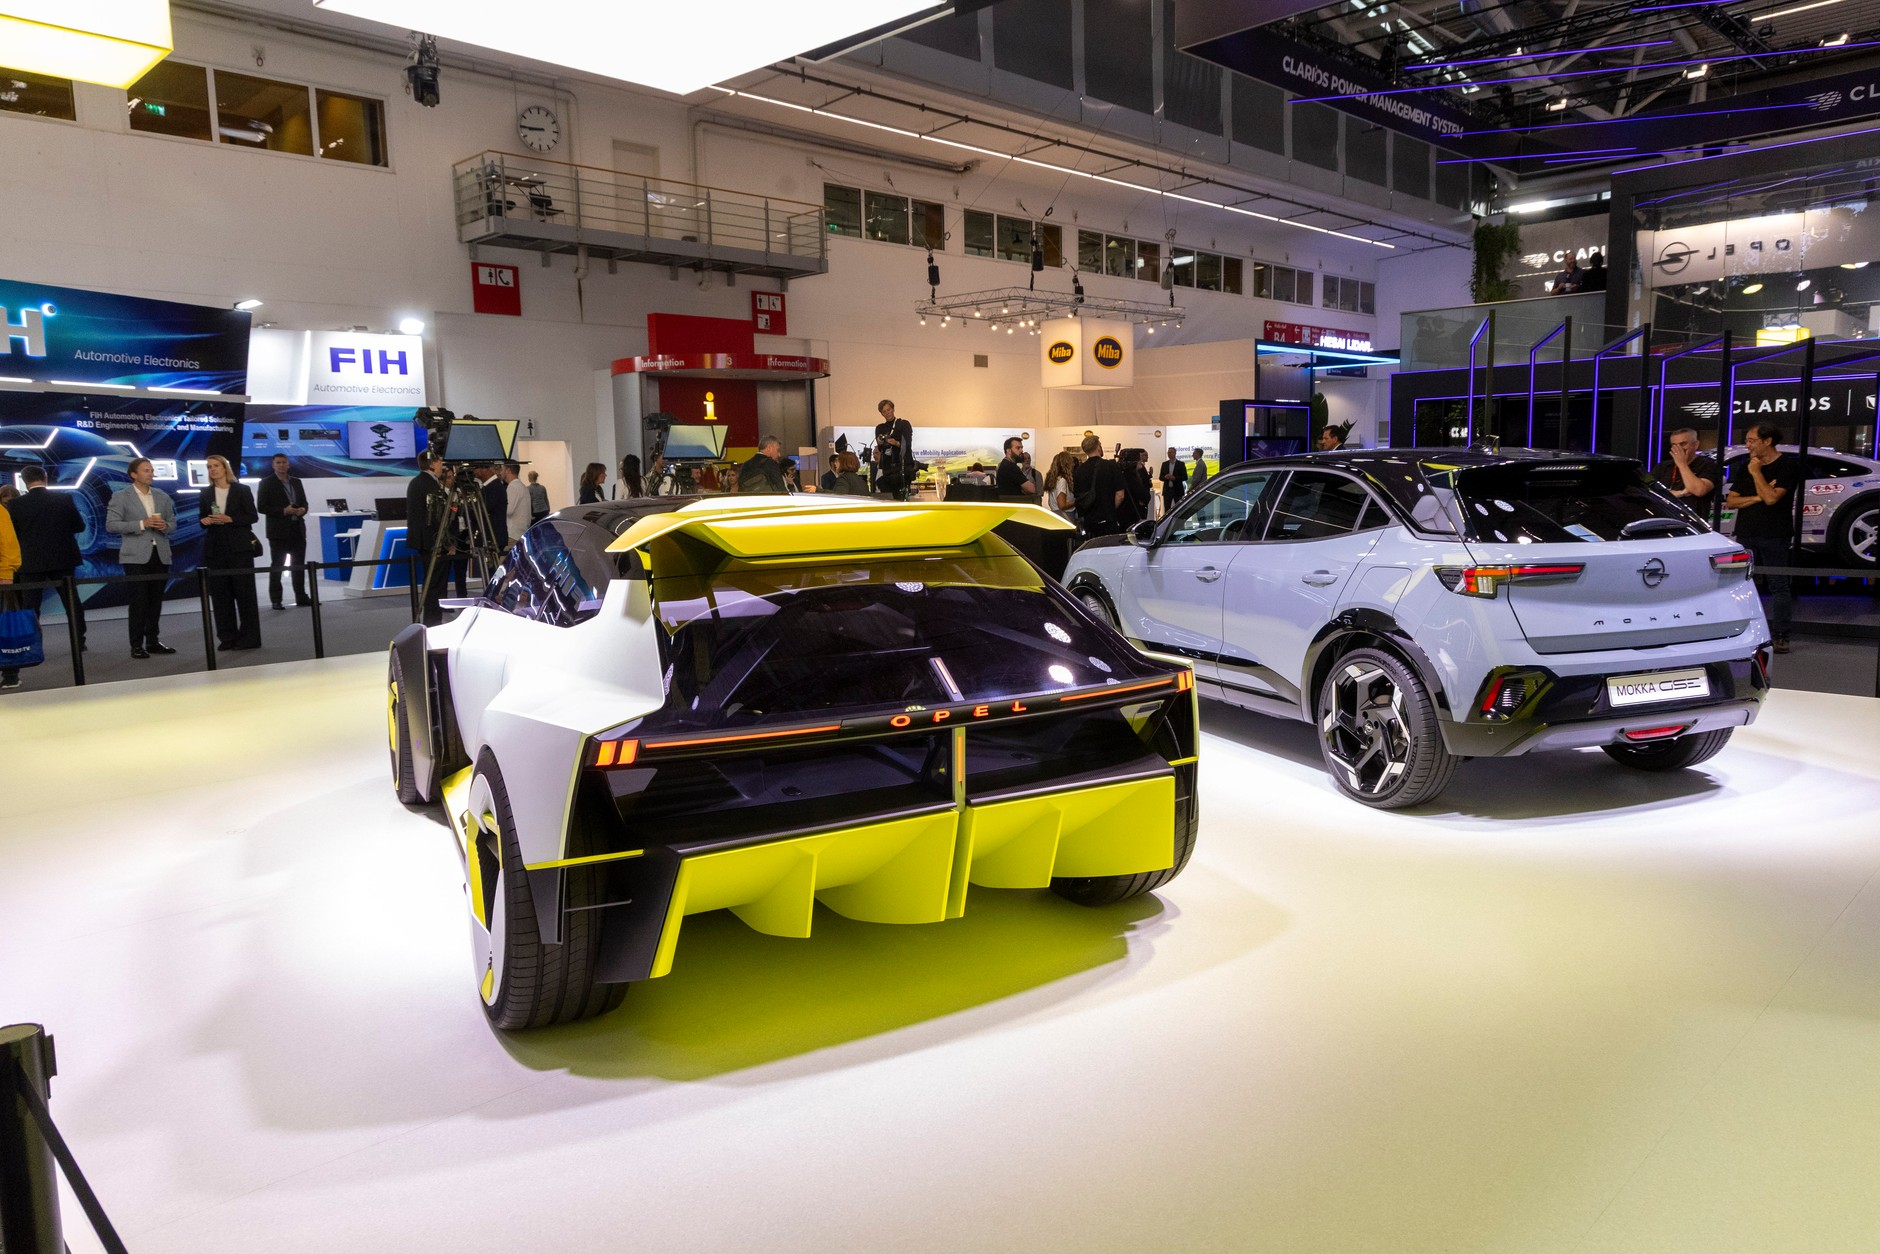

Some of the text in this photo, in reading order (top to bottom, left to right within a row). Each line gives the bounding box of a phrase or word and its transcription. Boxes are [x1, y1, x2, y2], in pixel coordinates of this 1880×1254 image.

[1283, 56, 1464, 139] CLARIOS POWER MANAGEMENT SYSTEM
[1553, 245, 1606, 262] CARI
[1052, 347, 1071, 358] Miba
[1098, 344, 1119, 359] Miba
[75, 349, 200, 370] Automotive Electronics
[329, 347, 408, 375] FIH
[641, 359, 684, 368] Information
[768, 357, 807, 368] Information
[313, 383, 421, 395] Automotive Electronics
[104, 412, 144, 421] Automotive
[145, 414, 182, 422] Electronics
[183, 415, 208, 423] Tailored
[76, 420, 94, 428] R&D
[95, 421, 140, 431] Engineering,
[141, 422, 176, 431] Validation,
[190, 424, 234, 433] Manufacturing
[1593, 611, 1704, 626] MOKKA
[1616, 677, 1701, 697] MOKKA GSE
[890, 700, 1027, 727] OPEL
